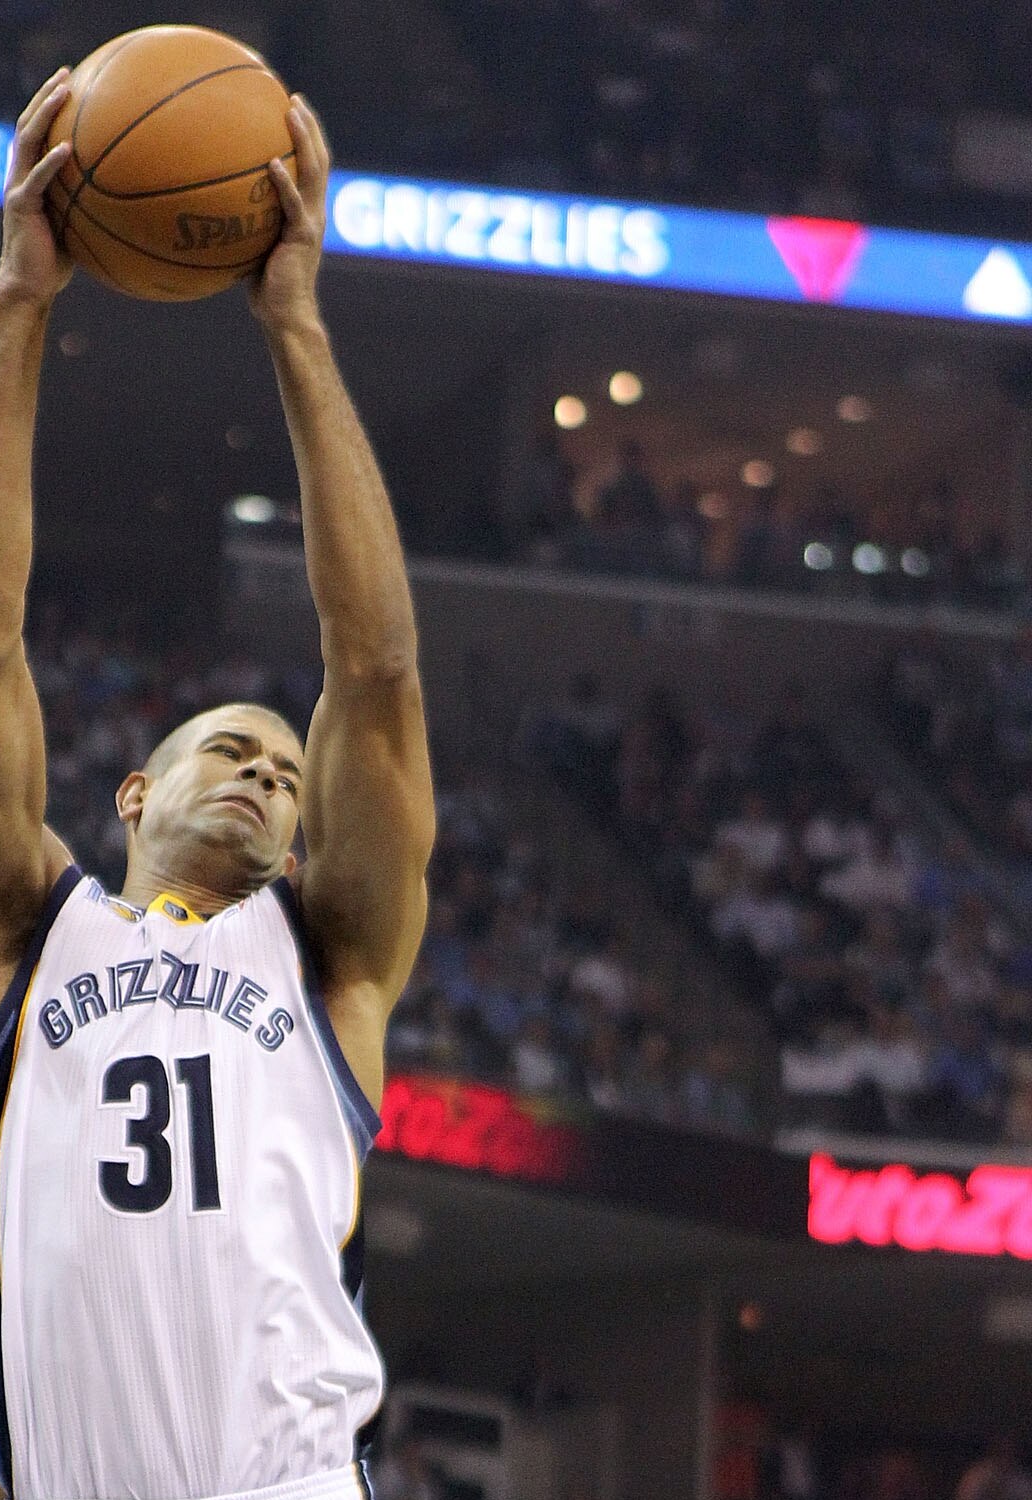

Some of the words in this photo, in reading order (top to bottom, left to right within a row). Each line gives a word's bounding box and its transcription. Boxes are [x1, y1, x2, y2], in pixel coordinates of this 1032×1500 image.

[333, 178, 668, 279] GRIZZLIES
[38, 950, 295, 1052] GRIZZLIES
[98, 1054, 222, 1214] 31
